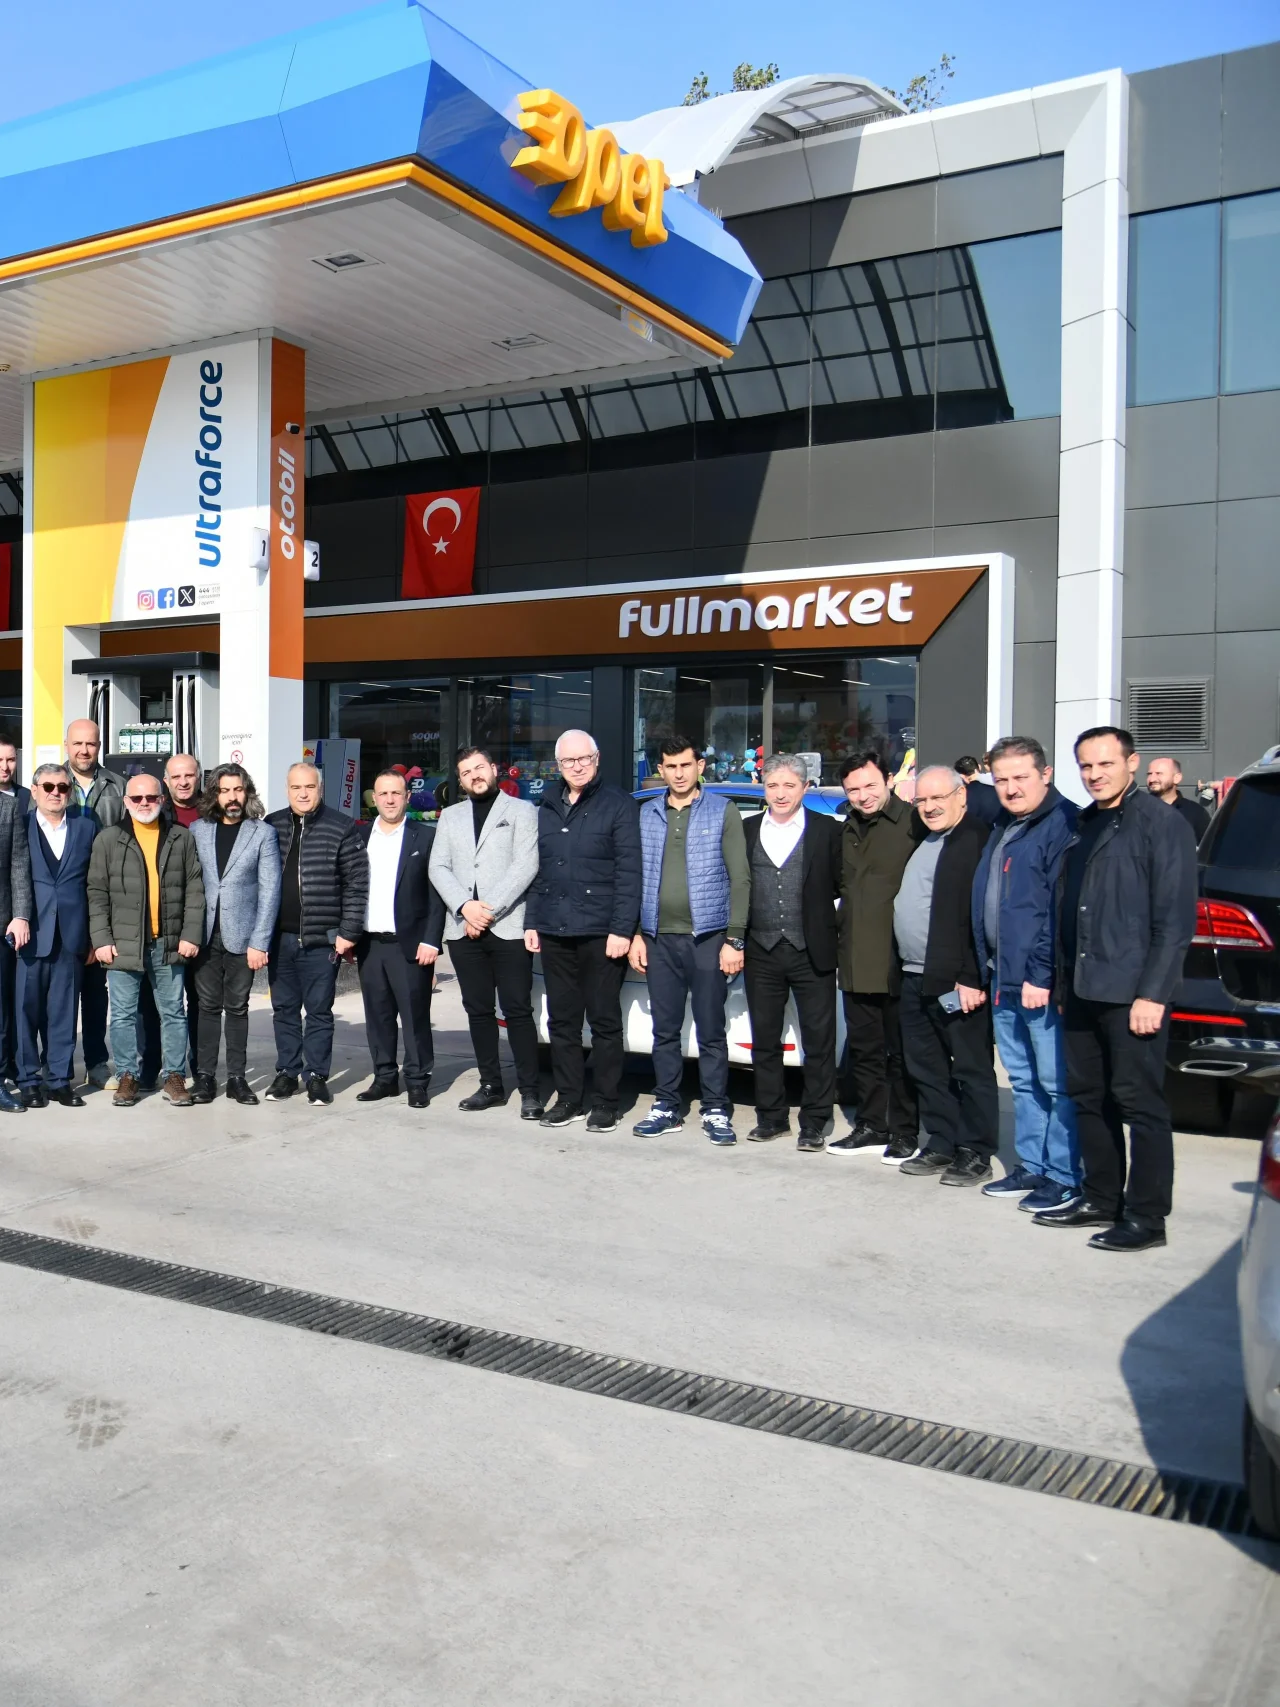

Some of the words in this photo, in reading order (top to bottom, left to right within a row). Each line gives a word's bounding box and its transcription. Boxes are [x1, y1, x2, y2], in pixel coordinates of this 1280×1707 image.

[511, 88, 670, 248] opet
[195, 359, 223, 568] ultraforce
[279, 447, 295, 560] otobil
[262, 540, 266, 556] 1
[311, 551, 319, 567] 2
[619, 582, 914, 639] fullmarket
[346, 759, 356, 783] Bull
[343, 784, 353, 808] Red
